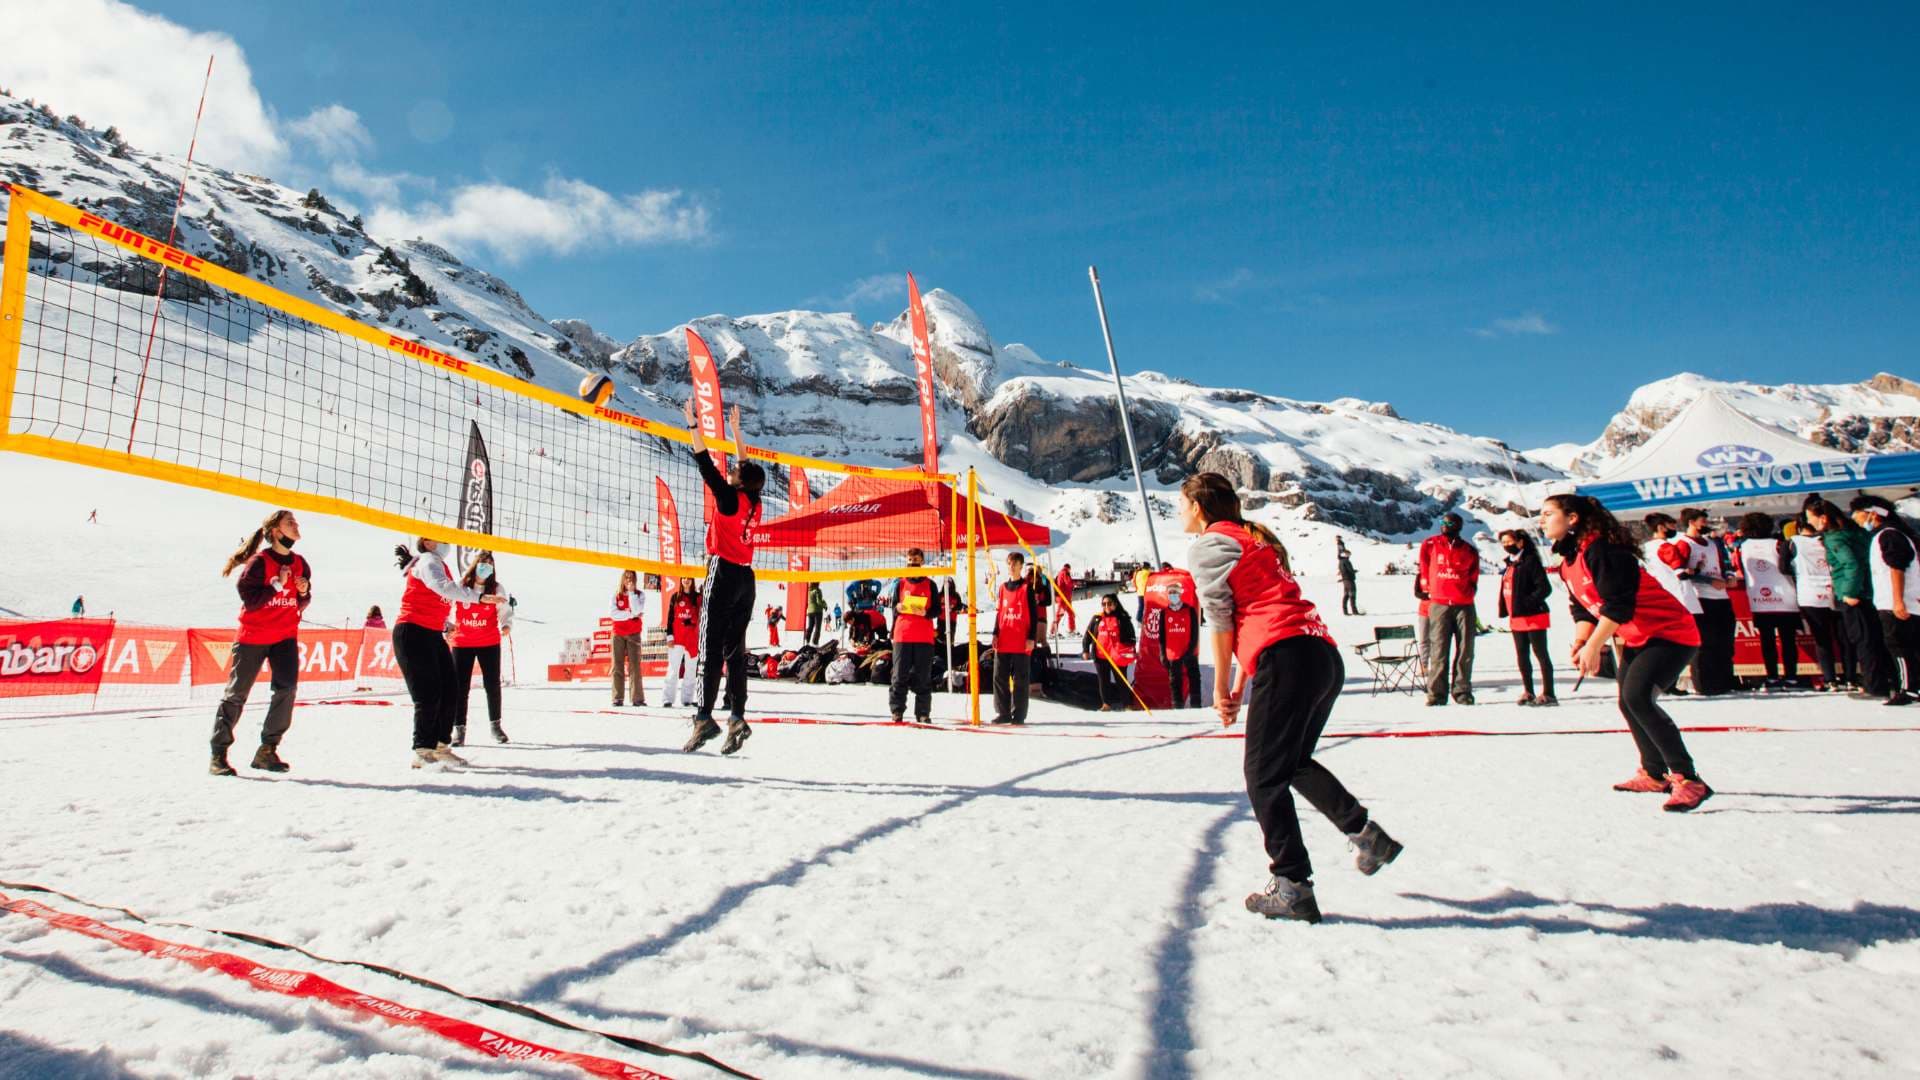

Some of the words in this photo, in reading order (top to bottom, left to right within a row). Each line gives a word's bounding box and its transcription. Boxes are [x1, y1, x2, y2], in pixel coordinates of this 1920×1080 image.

[746, 446, 779, 460] UNTEC
[1632, 456, 1870, 500] WATERVOLEY
[255, 971, 308, 989] AMBAR
[366, 997, 422, 1020] AMBAR
[488, 1038, 557, 1062] AMBAR
